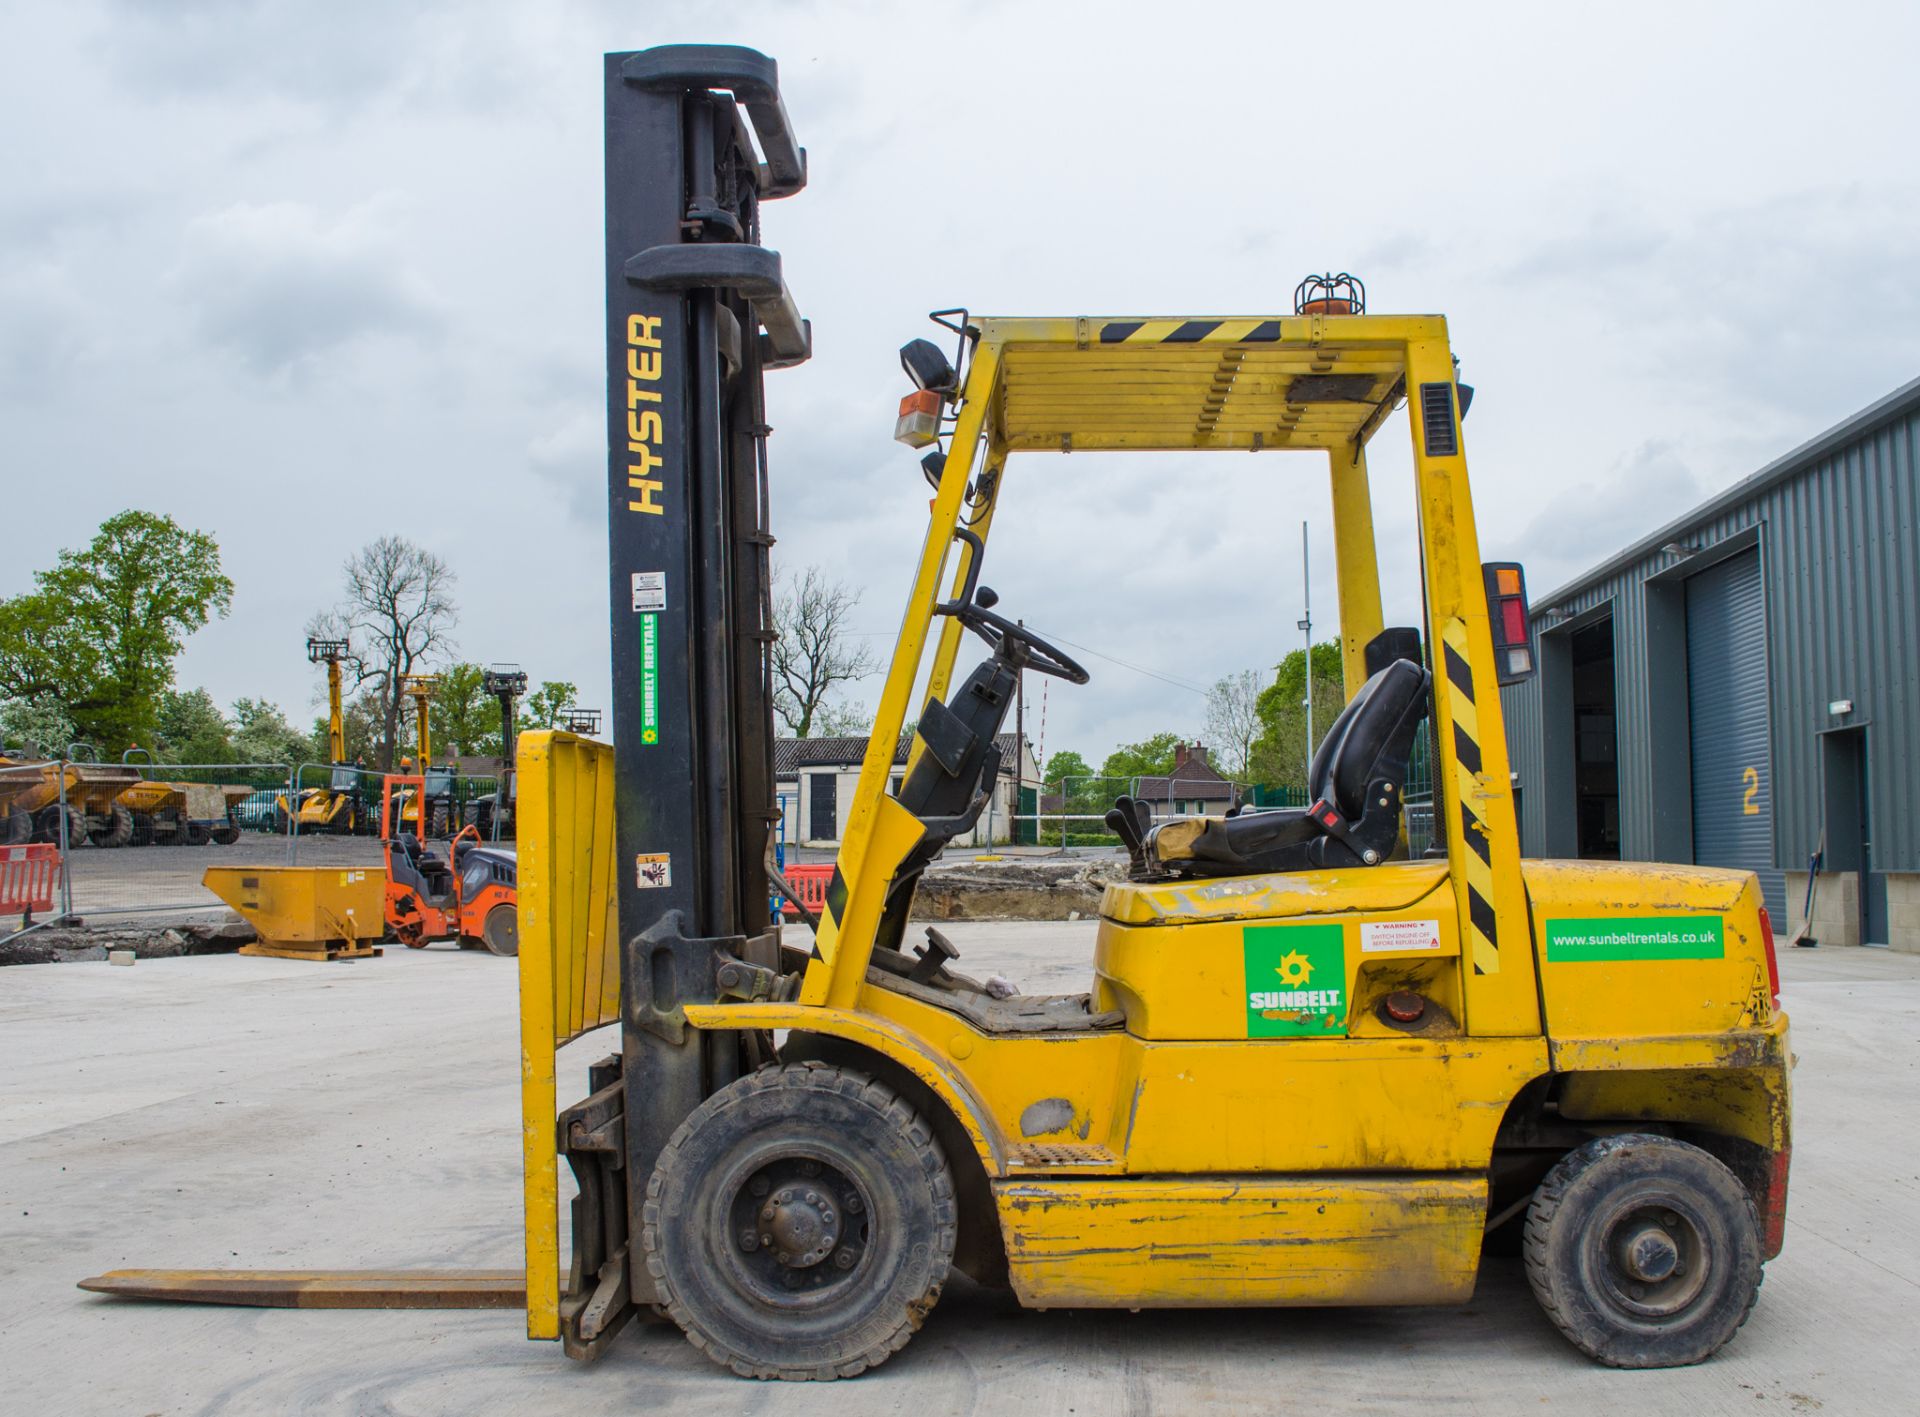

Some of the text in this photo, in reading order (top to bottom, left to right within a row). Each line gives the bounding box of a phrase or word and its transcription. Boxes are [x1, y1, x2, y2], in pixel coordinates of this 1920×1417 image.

[627, 313, 664, 515] HYSTER
[644, 614, 655, 727] SUNBELT RENTALS
[1743, 767, 1760, 815] 2
[1553, 931, 1716, 946] www.sunbeltrentals.co.uk
[1250, 990, 1340, 1009] SUNBELT
